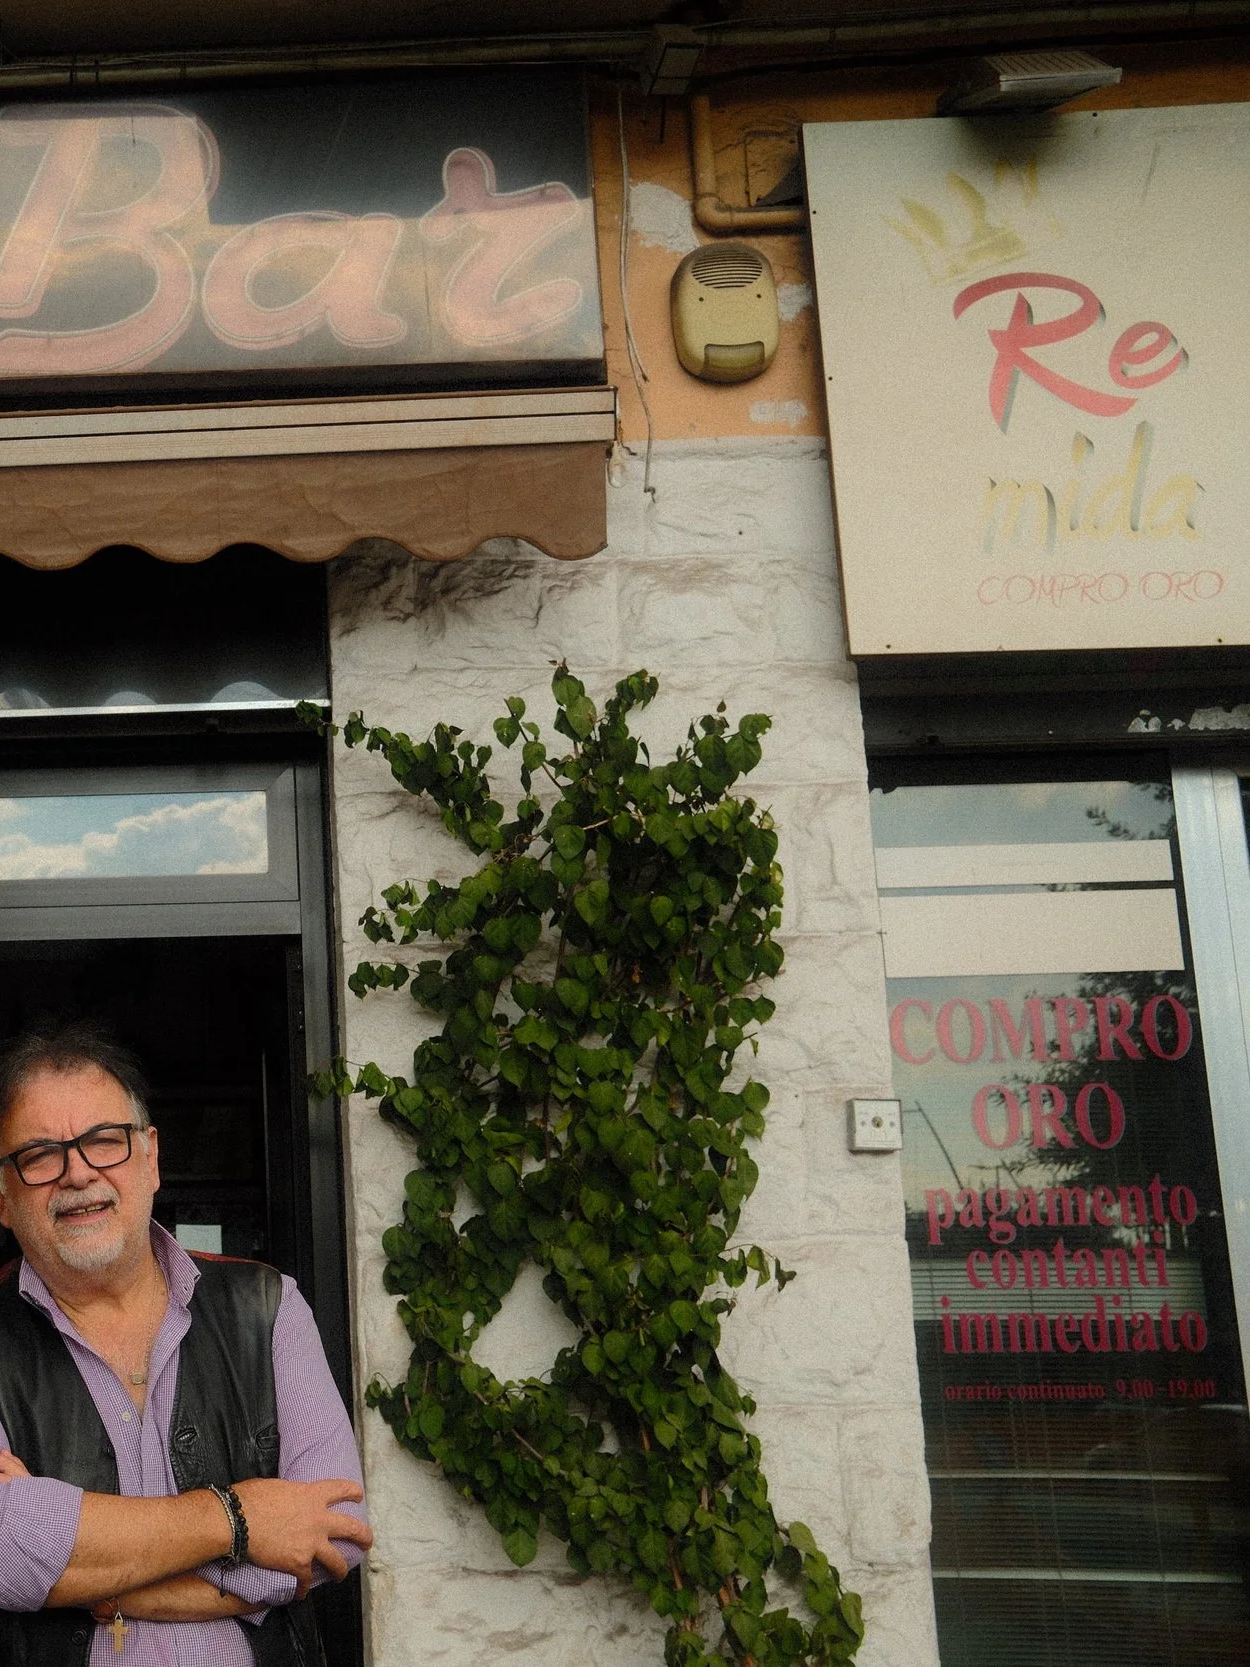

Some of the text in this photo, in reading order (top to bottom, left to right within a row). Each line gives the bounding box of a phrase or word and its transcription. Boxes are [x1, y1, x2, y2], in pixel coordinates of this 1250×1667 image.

[953, 272, 1189, 434] Re
[976, 420, 1205, 556] mida
[977, 570, 1225, 608] COMPRO ORO
[889, 994, 1192, 1064] COMPRO
[971, 1082, 1126, 1150] ORO
[924, 1174, 1198, 1246] pagamento
[965, 1231, 1170, 1290] contanti
[940, 1295, 1208, 1354] immediato
[944, 1381, 1000, 1400] orario
[1006, 1380, 1106, 1400] continuato
